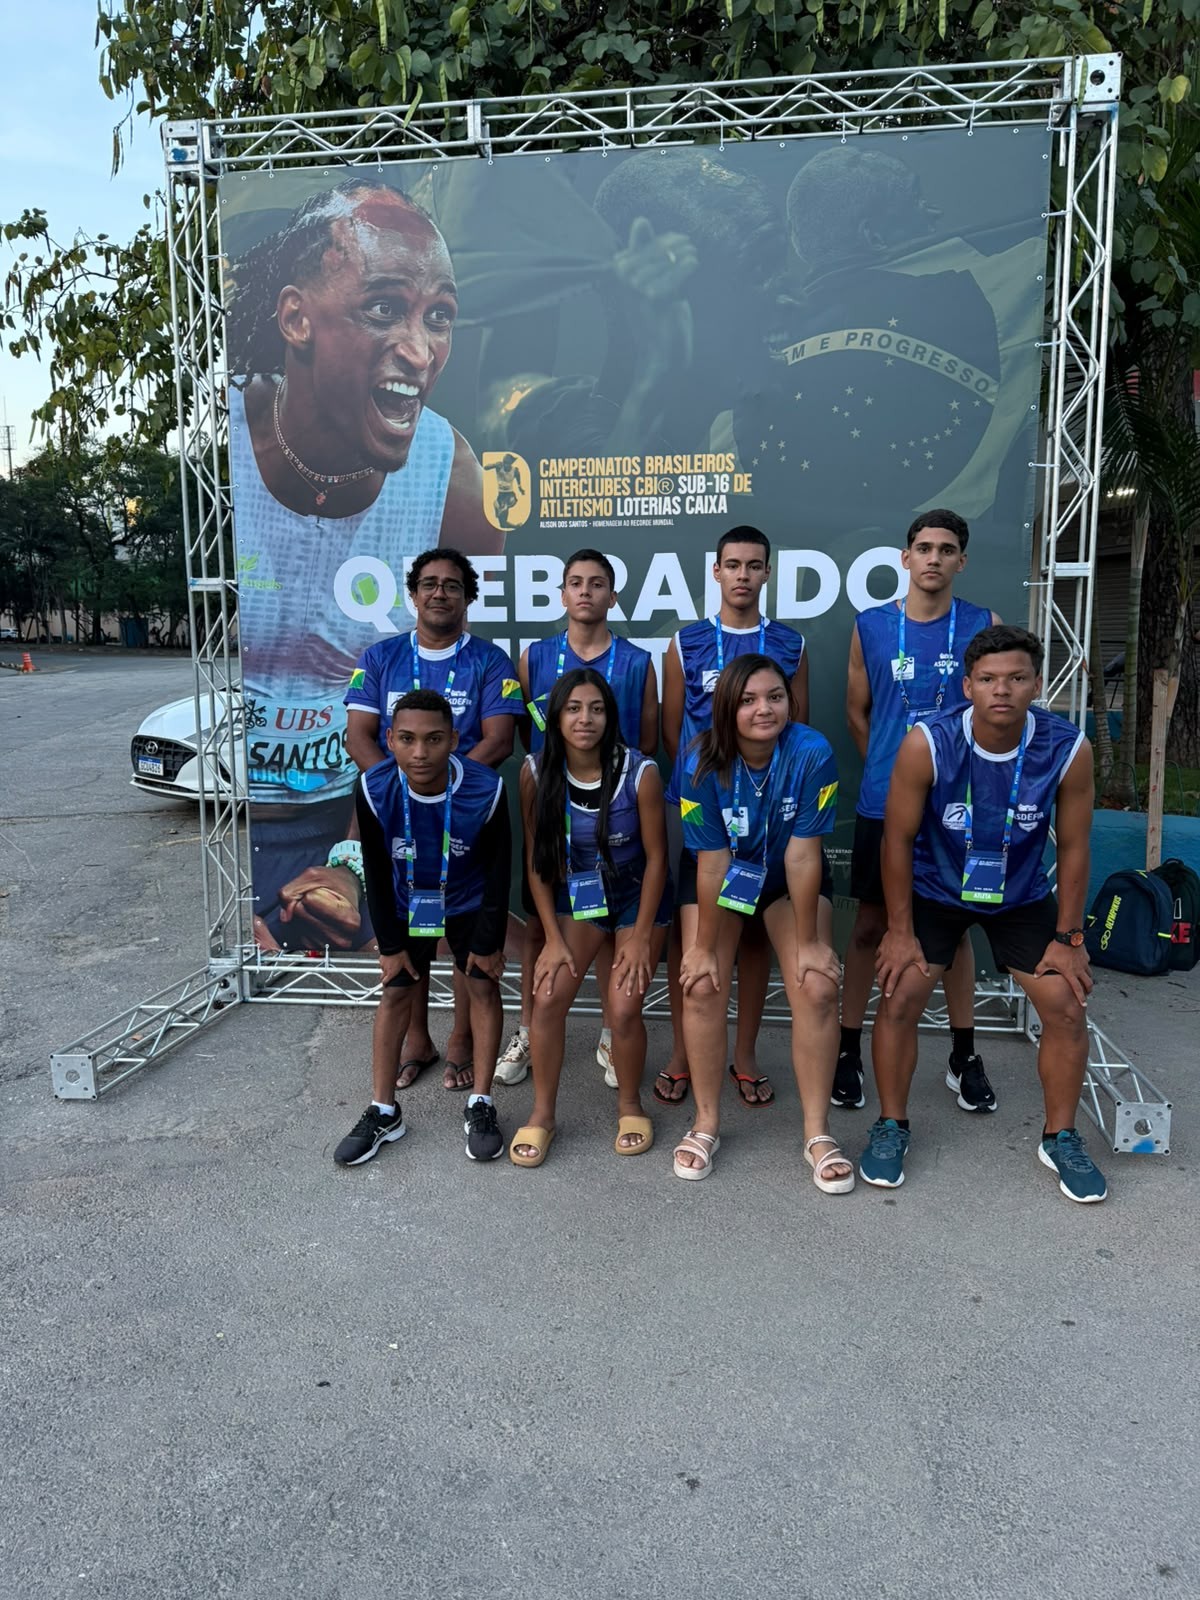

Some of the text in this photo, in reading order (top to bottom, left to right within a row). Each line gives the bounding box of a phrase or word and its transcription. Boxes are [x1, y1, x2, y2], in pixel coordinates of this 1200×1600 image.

[820, 337, 831, 350] E
[845, 332, 990, 393] PROGRESSO
[539, 453, 735, 478] CAMPEONATOS BRASILEIROS
[540, 476, 631, 498] INTERCLUBES
[678, 474, 729, 494] SUB-16
[733, 473, 752, 493] DE
[540, 494, 728, 518] ATLETISMO LOTERIAS CAIXA
[569, 520, 588, 528] SANTOS
[275, 704, 334, 731] UBS
